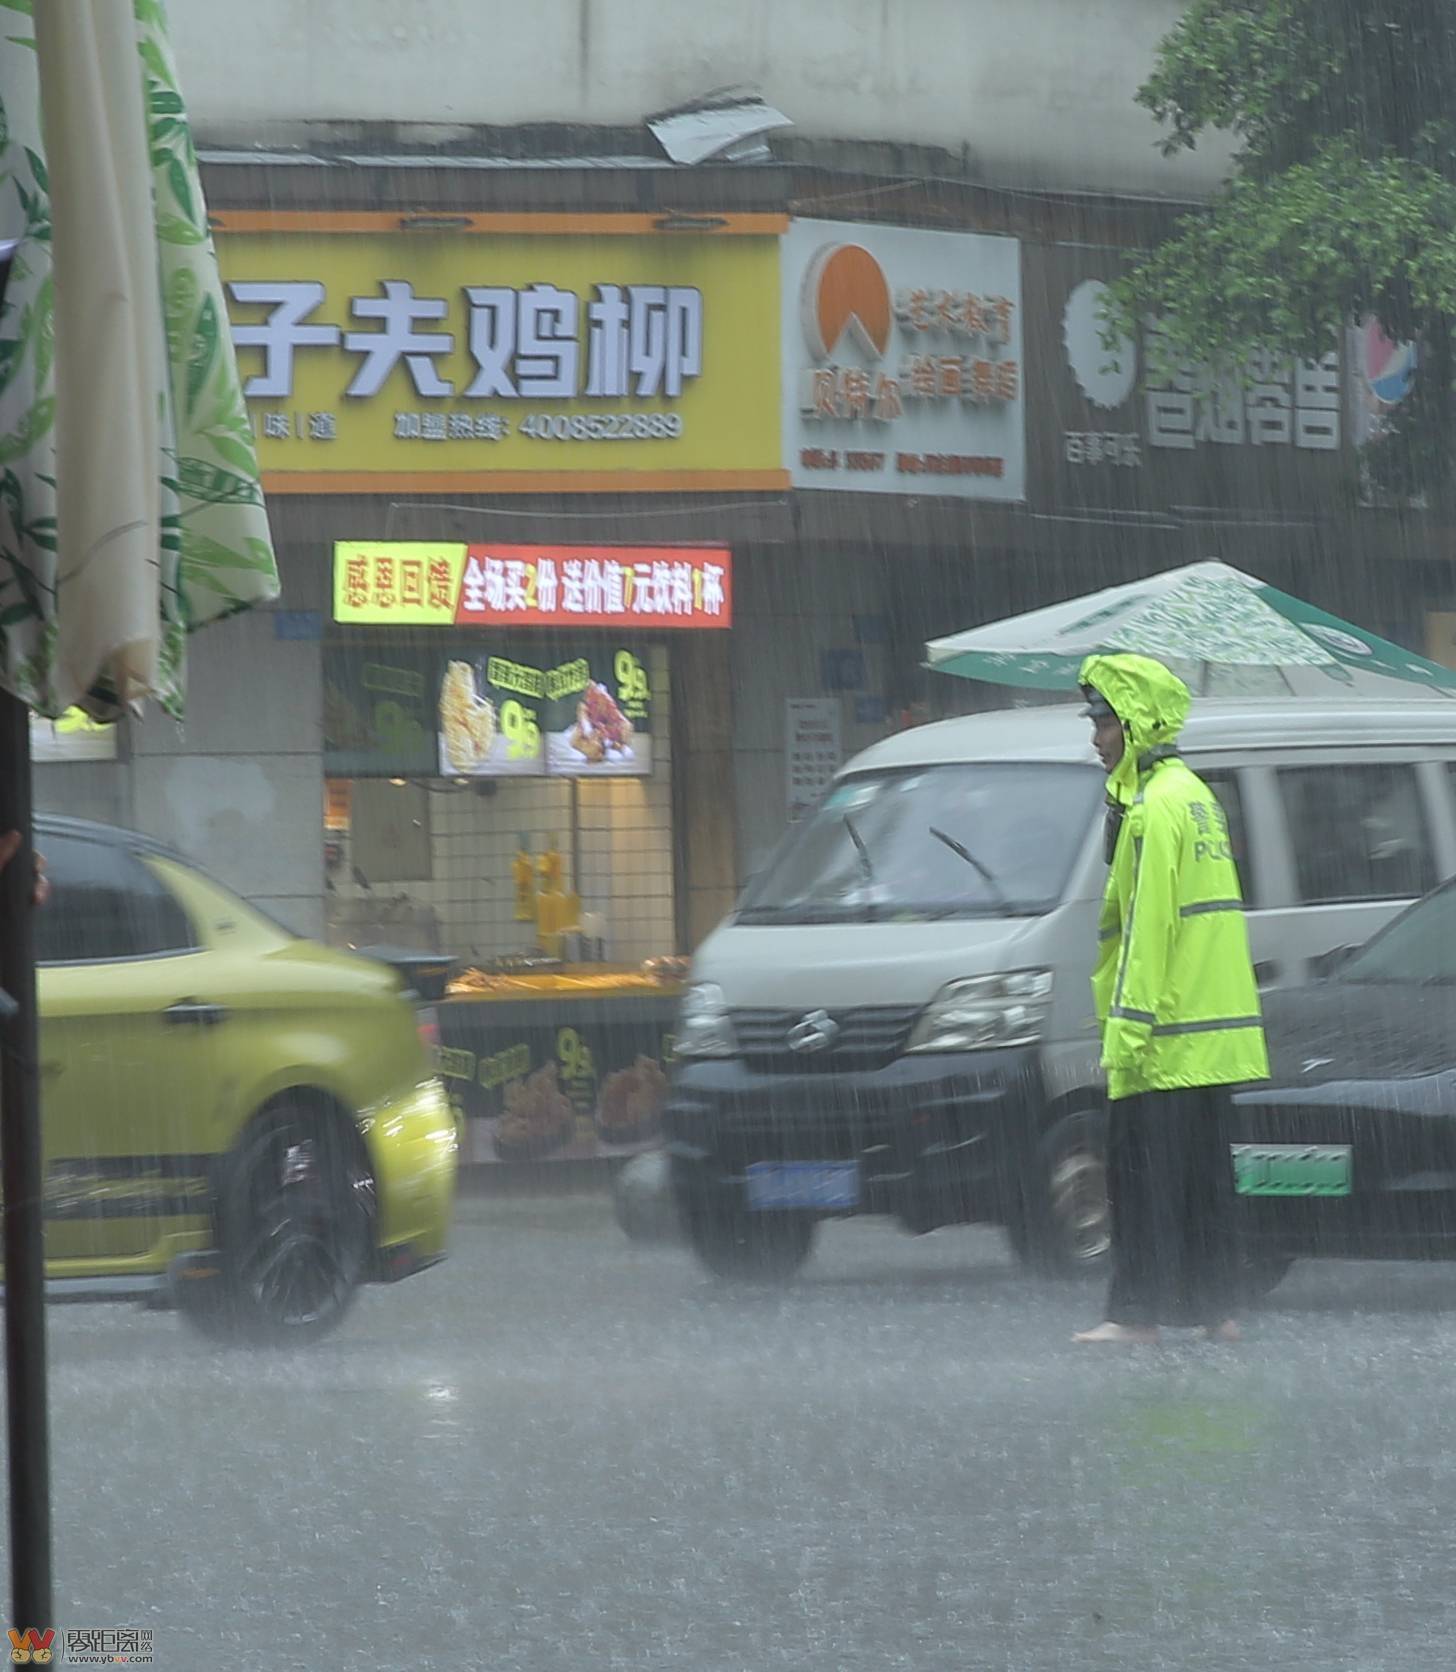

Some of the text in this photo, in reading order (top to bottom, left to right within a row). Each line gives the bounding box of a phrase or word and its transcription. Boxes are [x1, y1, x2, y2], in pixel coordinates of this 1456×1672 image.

[226, 279, 703, 399] 子夫鸡柳
[1064, 430, 1143, 467] 百事可乐
[344, 554, 455, 610] 感恩回馈
